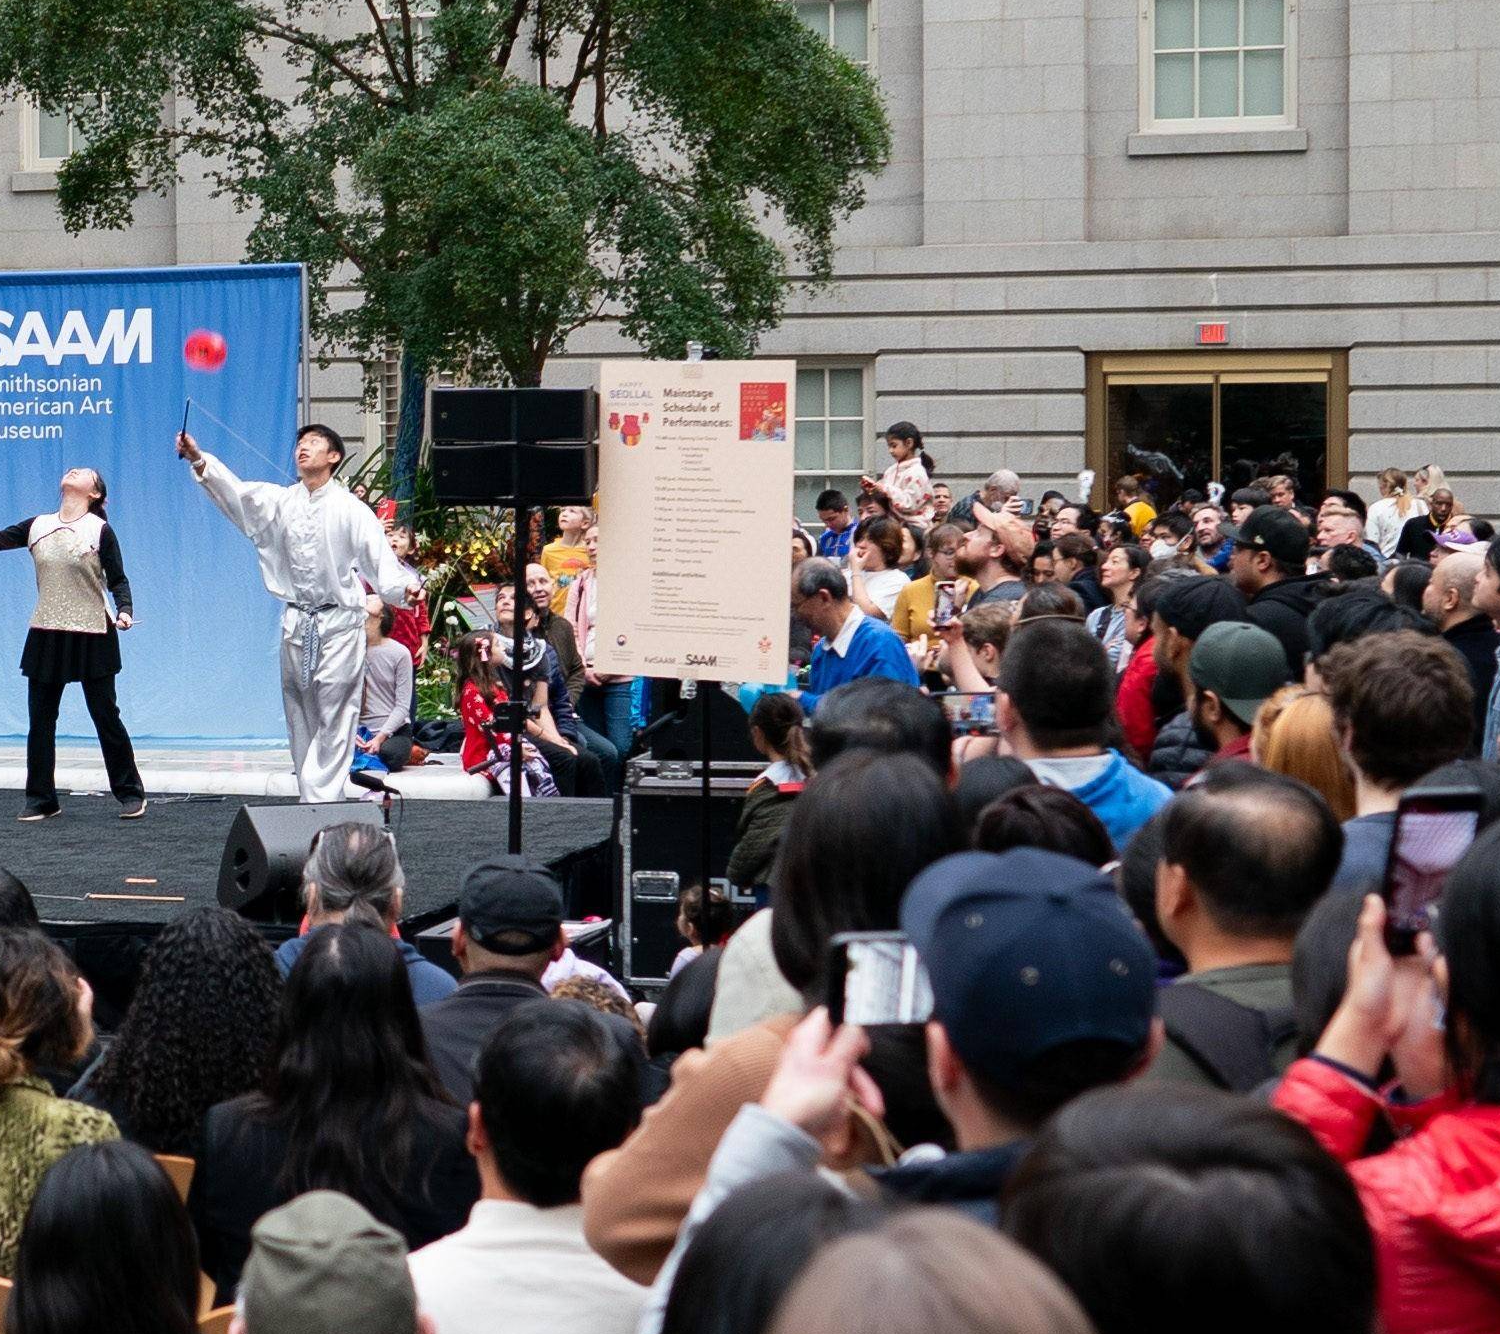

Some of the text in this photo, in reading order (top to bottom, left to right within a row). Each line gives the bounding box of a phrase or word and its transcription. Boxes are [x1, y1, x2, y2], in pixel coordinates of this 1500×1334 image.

[609, 389, 653, 399] SEOLLAL
[662, 388, 714, 399] Mainstage
[79, 397, 112, 415] Art
[662, 403, 707, 413] Schedule
[710, 402, 721, 412] of
[662, 417, 733, 428] Performances:
[684, 654, 718, 667] SAAM
